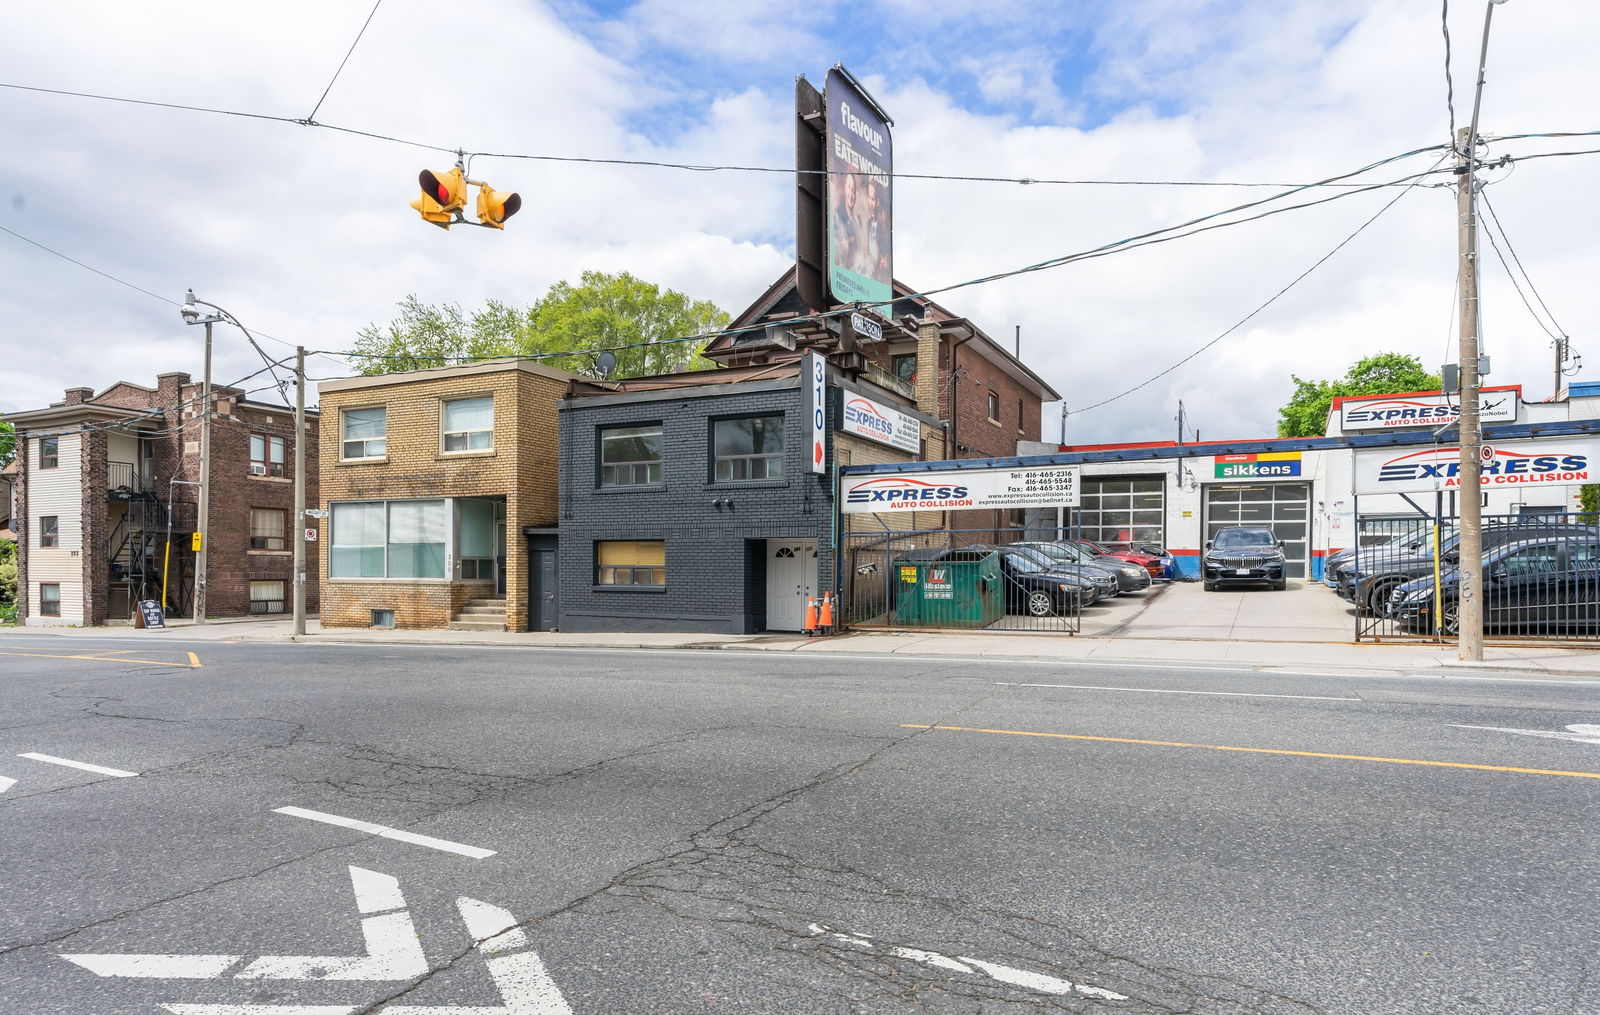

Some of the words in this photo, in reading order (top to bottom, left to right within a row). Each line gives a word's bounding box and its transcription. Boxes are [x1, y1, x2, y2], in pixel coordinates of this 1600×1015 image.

[841, 102, 882, 149] flavour
[835, 139, 851, 164] EAT
[859, 154, 889, 188] WORLD
[815, 361, 823, 430] 310
[845, 406, 892, 435] EXPRESS
[1384, 418, 1410, 426] AUTO
[1412, 416, 1457, 425] COLLISIO
[857, 425, 868, 435] AUTO
[1223, 464, 1291, 476] sikkens
[1494, 472, 1588, 484] COLLISION
[847, 486, 968, 503] EXPRESS
[919, 499, 973, 507] COLLISION
